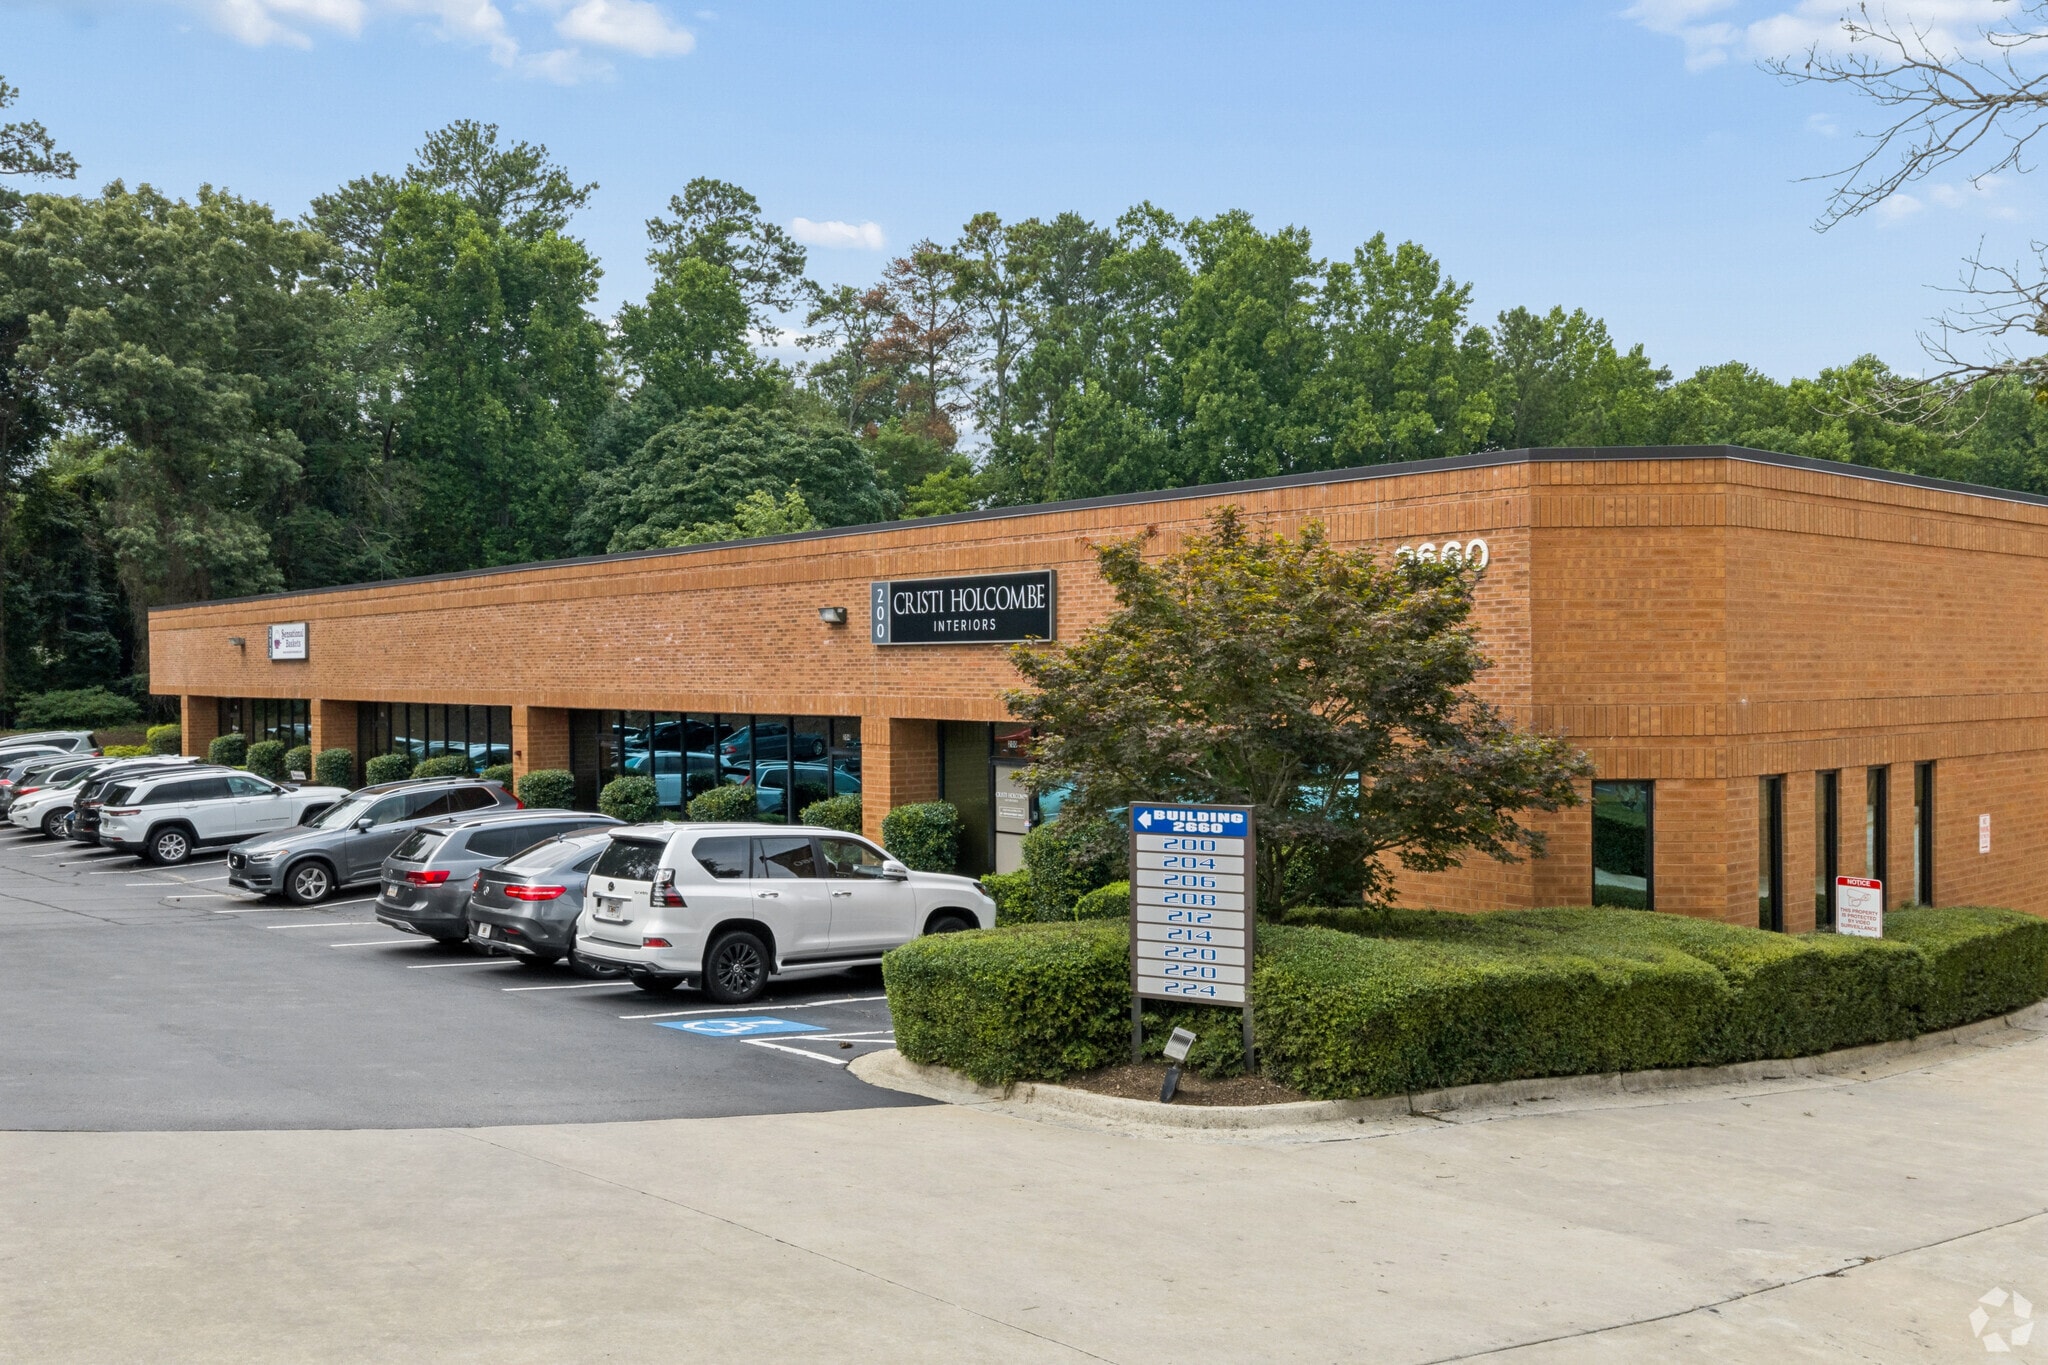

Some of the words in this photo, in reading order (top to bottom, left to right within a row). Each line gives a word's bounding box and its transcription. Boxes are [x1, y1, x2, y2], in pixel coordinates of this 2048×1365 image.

[893, 590, 943, 615] CRISTI
[950, 584, 1046, 612] HOLCOMBE
[876, 588, 885, 638] 200
[933, 618, 996, 632] INTERIORS
[1153, 810, 1244, 824] BUILDING
[1172, 822, 1223, 833] 2660
[1164, 838, 1216, 851] 200
[1164, 856, 1216, 870] 204
[1164, 874, 1216, 888] 206
[1847, 879, 1871, 887] NOTICE
[1164, 892, 1216, 906] 208
[1168, 910, 1212, 923] 212
[1840, 923, 1878, 931] SURVEILLANCE
[1168, 928, 1212, 942] 214
[1165, 946, 1217, 961] 220
[1165, 964, 1217, 979] 220
[1165, 981, 1217, 997] 224
